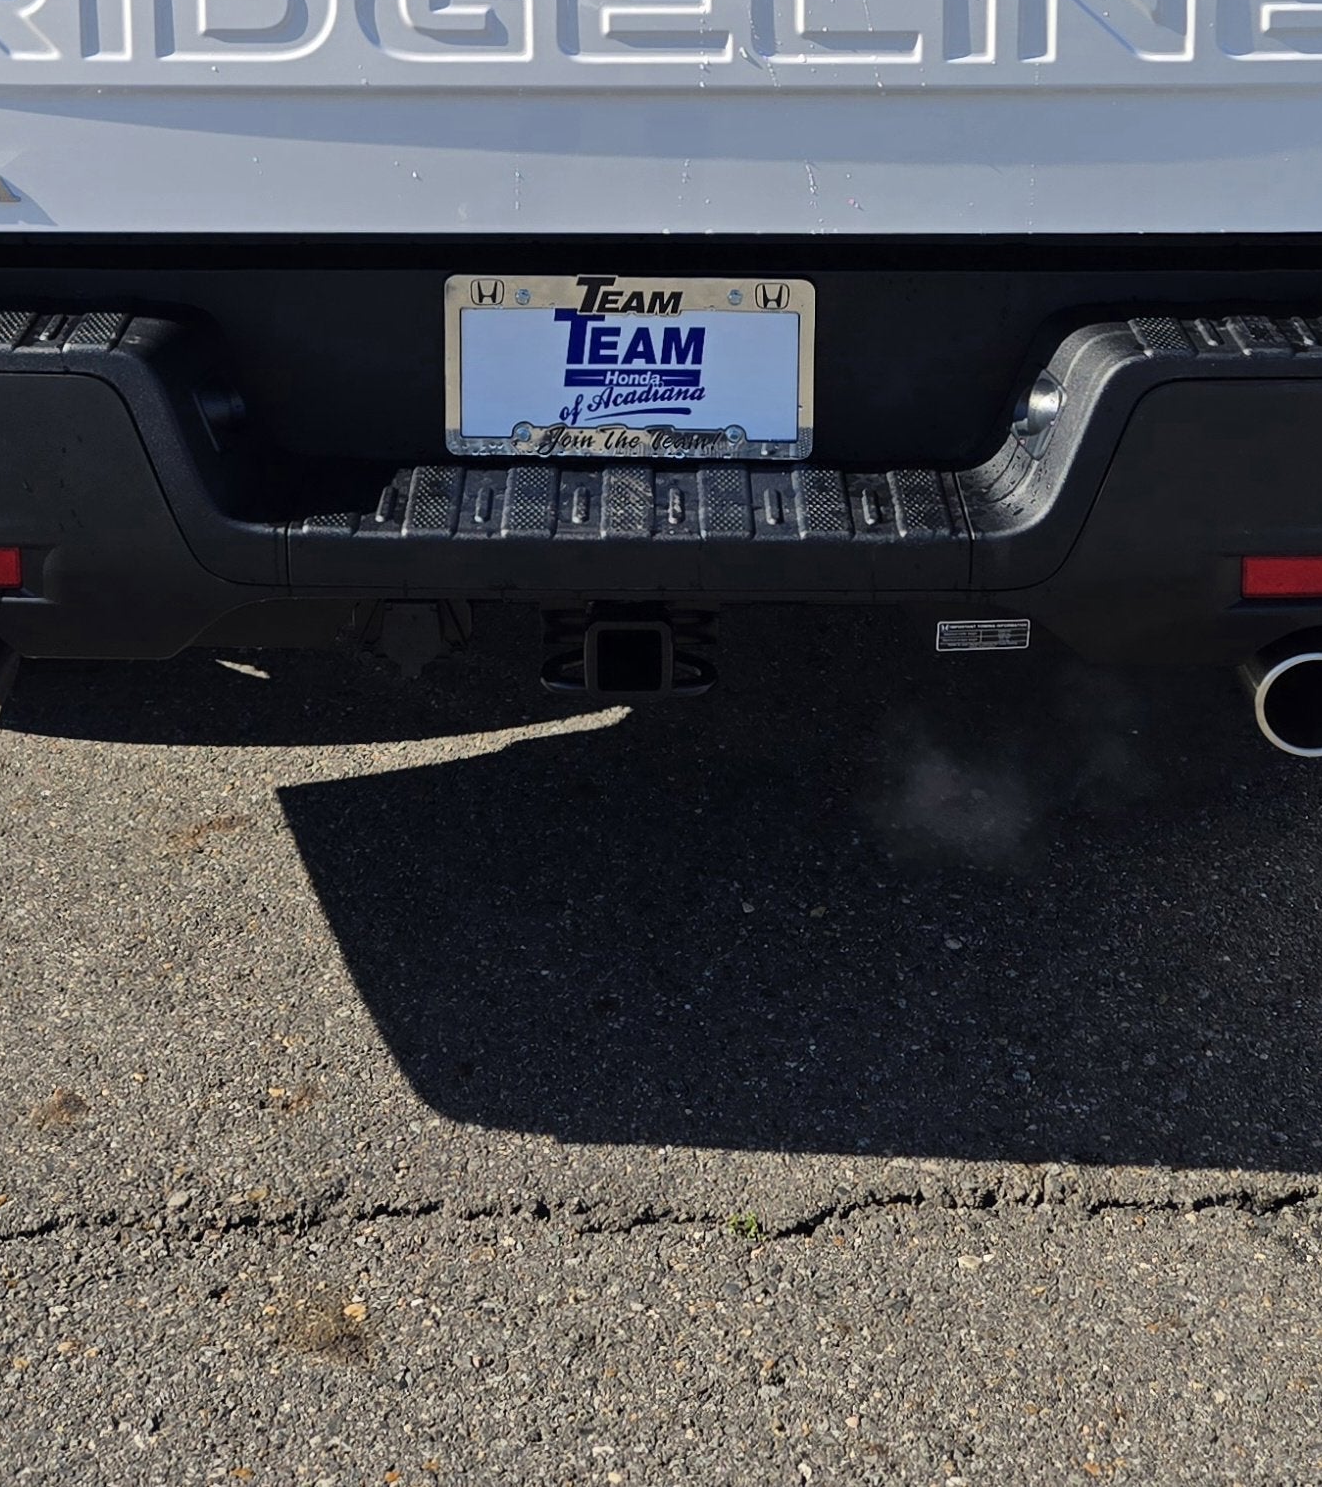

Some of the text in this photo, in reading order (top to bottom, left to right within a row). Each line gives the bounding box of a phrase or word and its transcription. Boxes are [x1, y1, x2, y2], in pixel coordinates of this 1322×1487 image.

[576, 276, 684, 316] TEAM
[553, 308, 706, 365] TEAM
[605, 371, 661, 386] Honda
[558, 384, 706, 425] of Acadiana
[537, 427, 595, 455] Join
[645, 428, 724, 451] Team!
